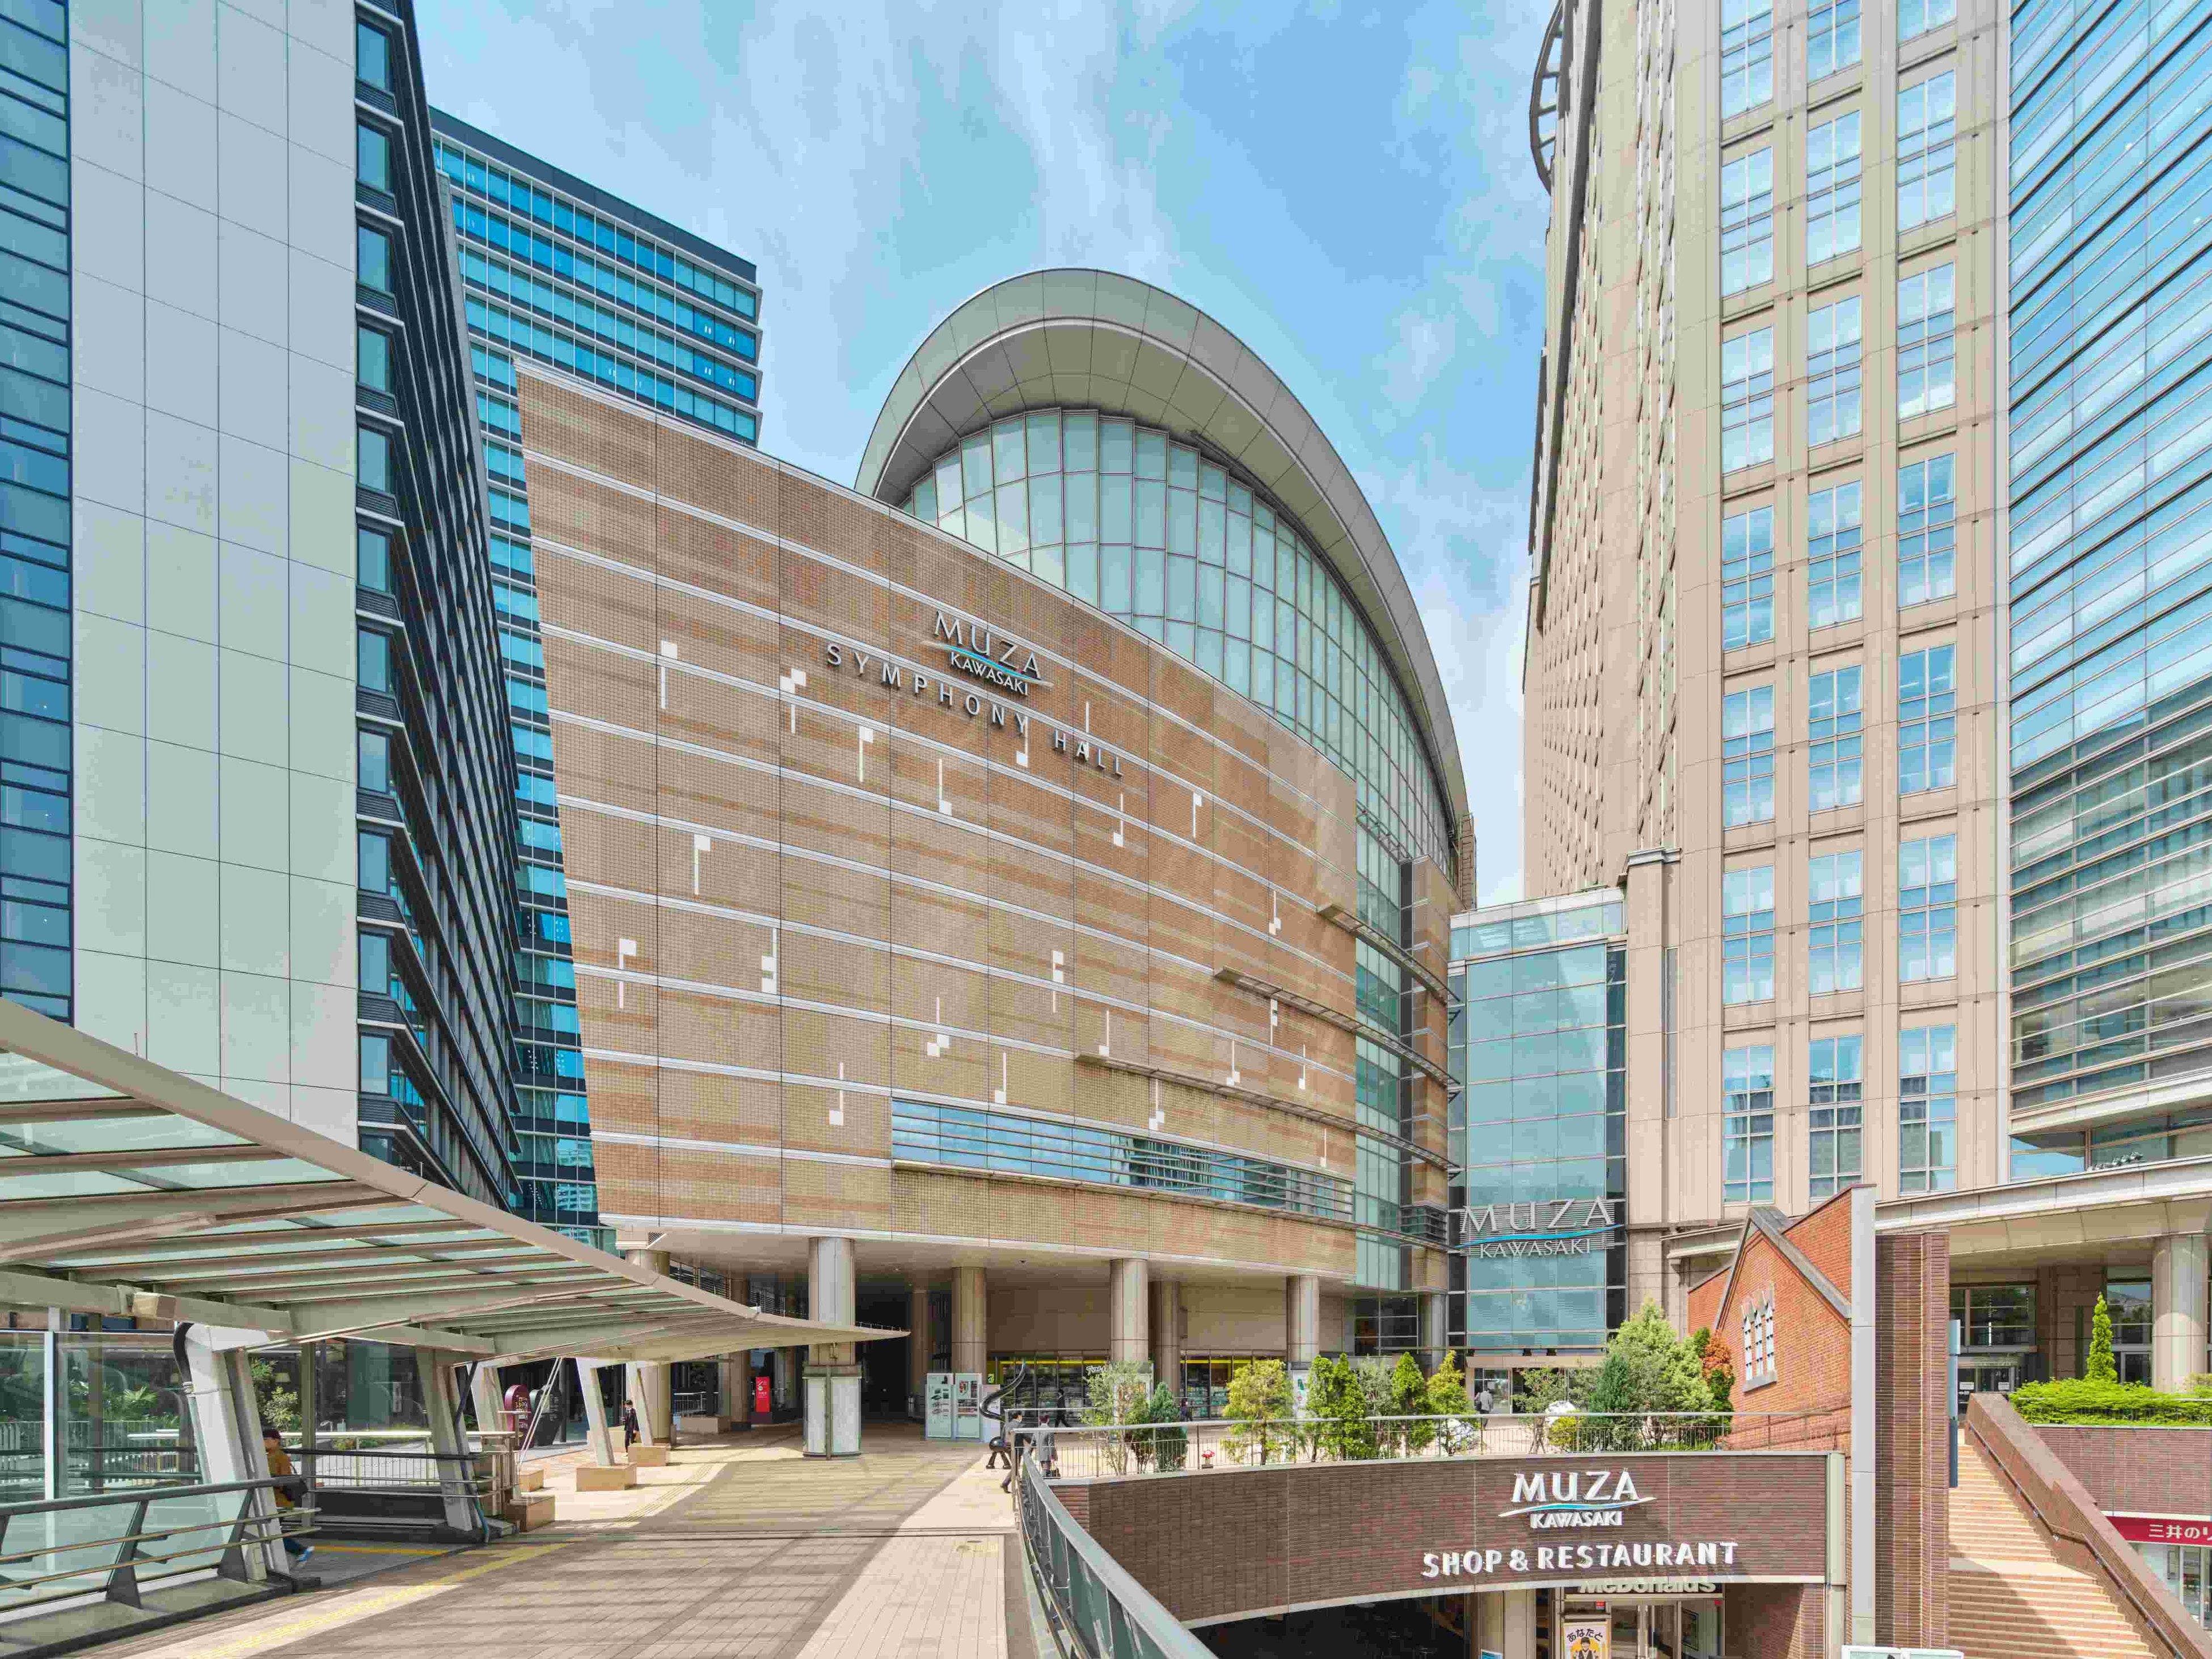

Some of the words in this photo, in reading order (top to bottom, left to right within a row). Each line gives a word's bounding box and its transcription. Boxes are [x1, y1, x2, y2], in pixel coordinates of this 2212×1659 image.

[934, 610, 1042, 679] MUZA
[950, 652, 1028, 695] KAWASAKI
[826, 643, 1029, 734] SYMPHONY
[1054, 729, 1123, 776] HALL
[1460, 1195, 1615, 1234] MUZA
[1480, 1238, 1590, 1259] KAWASAKI
[1511, 1469, 1640, 1502] MUZA
[1530, 1511, 1623, 1529] KAWASAKI
[1422, 1550, 1502, 1578] SHOP
[1509, 1548, 1529, 1572] &
[1538, 1542, 1739, 1570] RESTAURANT
[1567, 1628, 1603, 1643] あなたと
